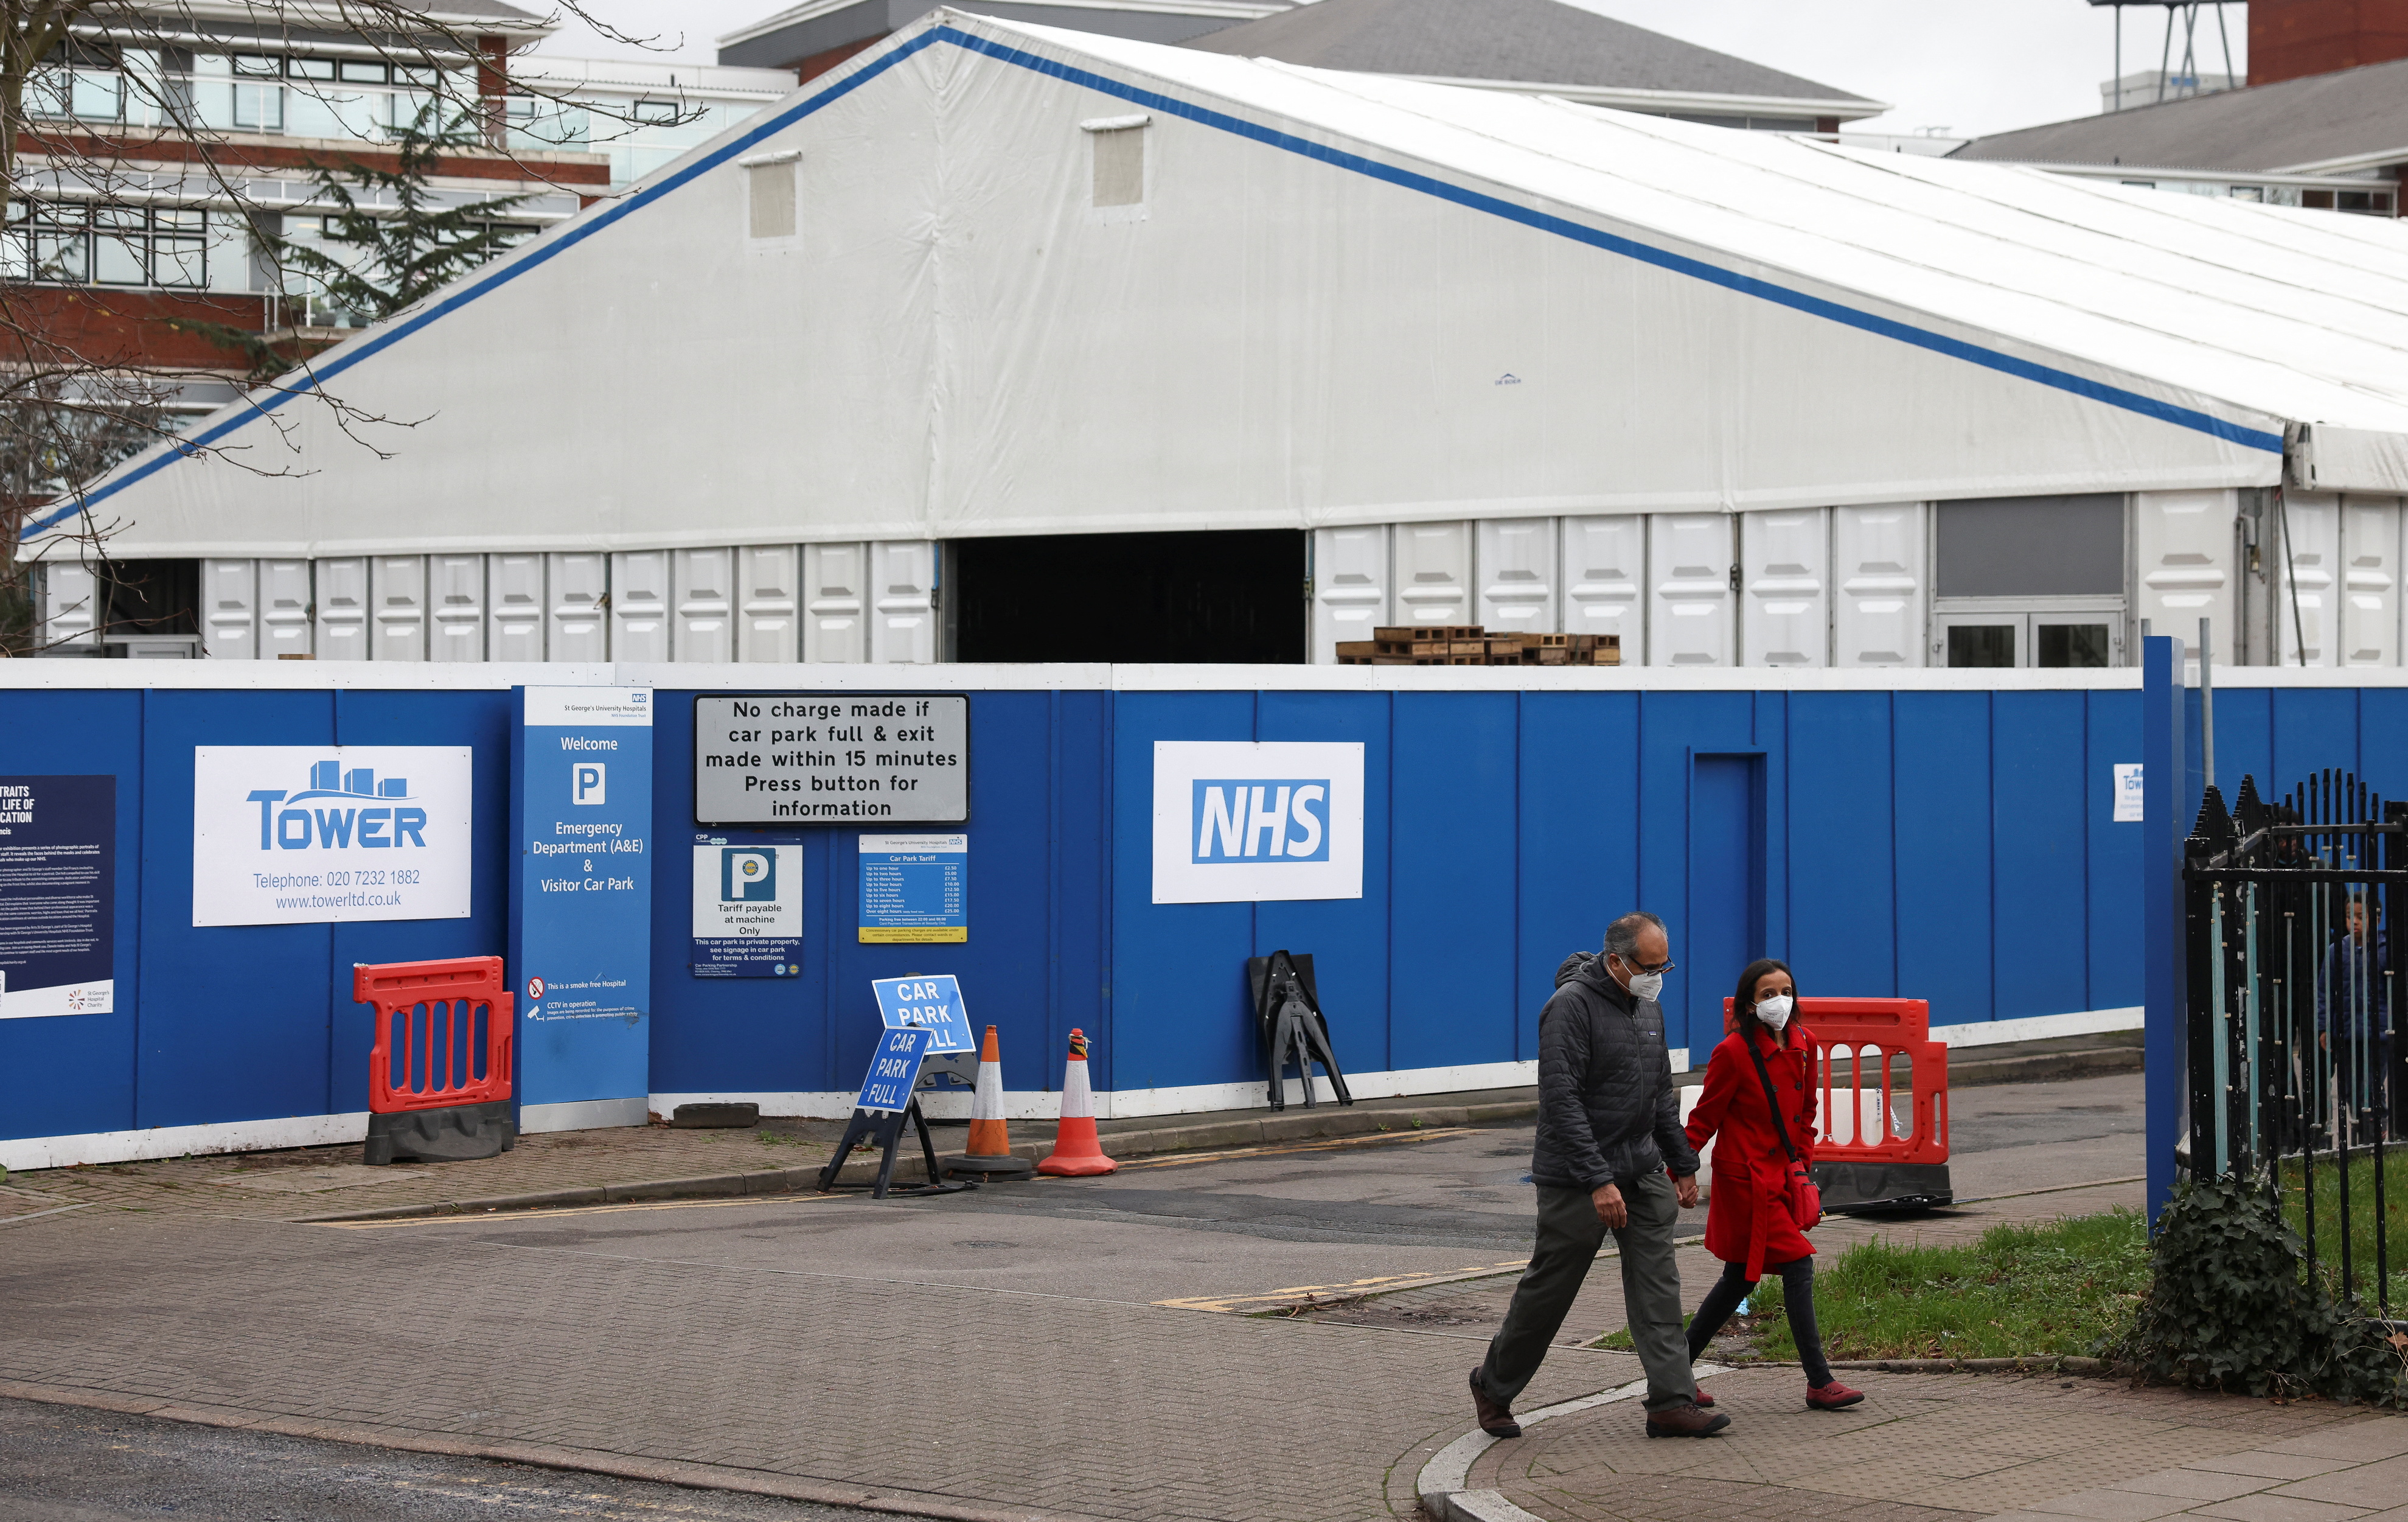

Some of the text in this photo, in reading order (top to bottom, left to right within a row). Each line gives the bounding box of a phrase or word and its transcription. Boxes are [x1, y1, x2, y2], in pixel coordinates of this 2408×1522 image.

[633, 694, 646, 702] NHS
[733, 701, 930, 719] No charge made if
[560, 736, 618, 750] Welcome
[729, 725, 934, 744] car park full & exit
[706, 750, 957, 767] made within 15 minutes
[579, 768, 599, 800] P
[745, 775, 918, 791] Press button for
[2123, 776, 2143, 789] TOW
[2, 798, 35, 810] LIFE OF
[773, 800, 891, 815] information
[246, 790, 426, 850] TOWER
[1198, 784, 1324, 857] NHS
[555, 822, 622, 837] Emergency
[533, 838, 643, 857] Department (A&E)
[583, 859, 593, 872] &
[254, 870, 420, 890] Telephone: 020 7232 1882
[541, 876, 634, 892] Visitor Car Park
[732, 853, 769, 898] P
[276, 891, 401, 909] www.towerltd.co.uk
[746, 904, 782, 913] payable
[739, 927, 760, 936] Only
[602, 980, 626, 988] Hospital
[897, 982, 940, 1002] CAR
[569, 1000, 596, 1009] operation
[897, 1005, 953, 1026] PARK
[889, 1033, 916, 1052] CAR
[928, 1030, 957, 1049] LL
[875, 1058, 911, 1078] PARK
[867, 1083, 896, 1105] FULL
